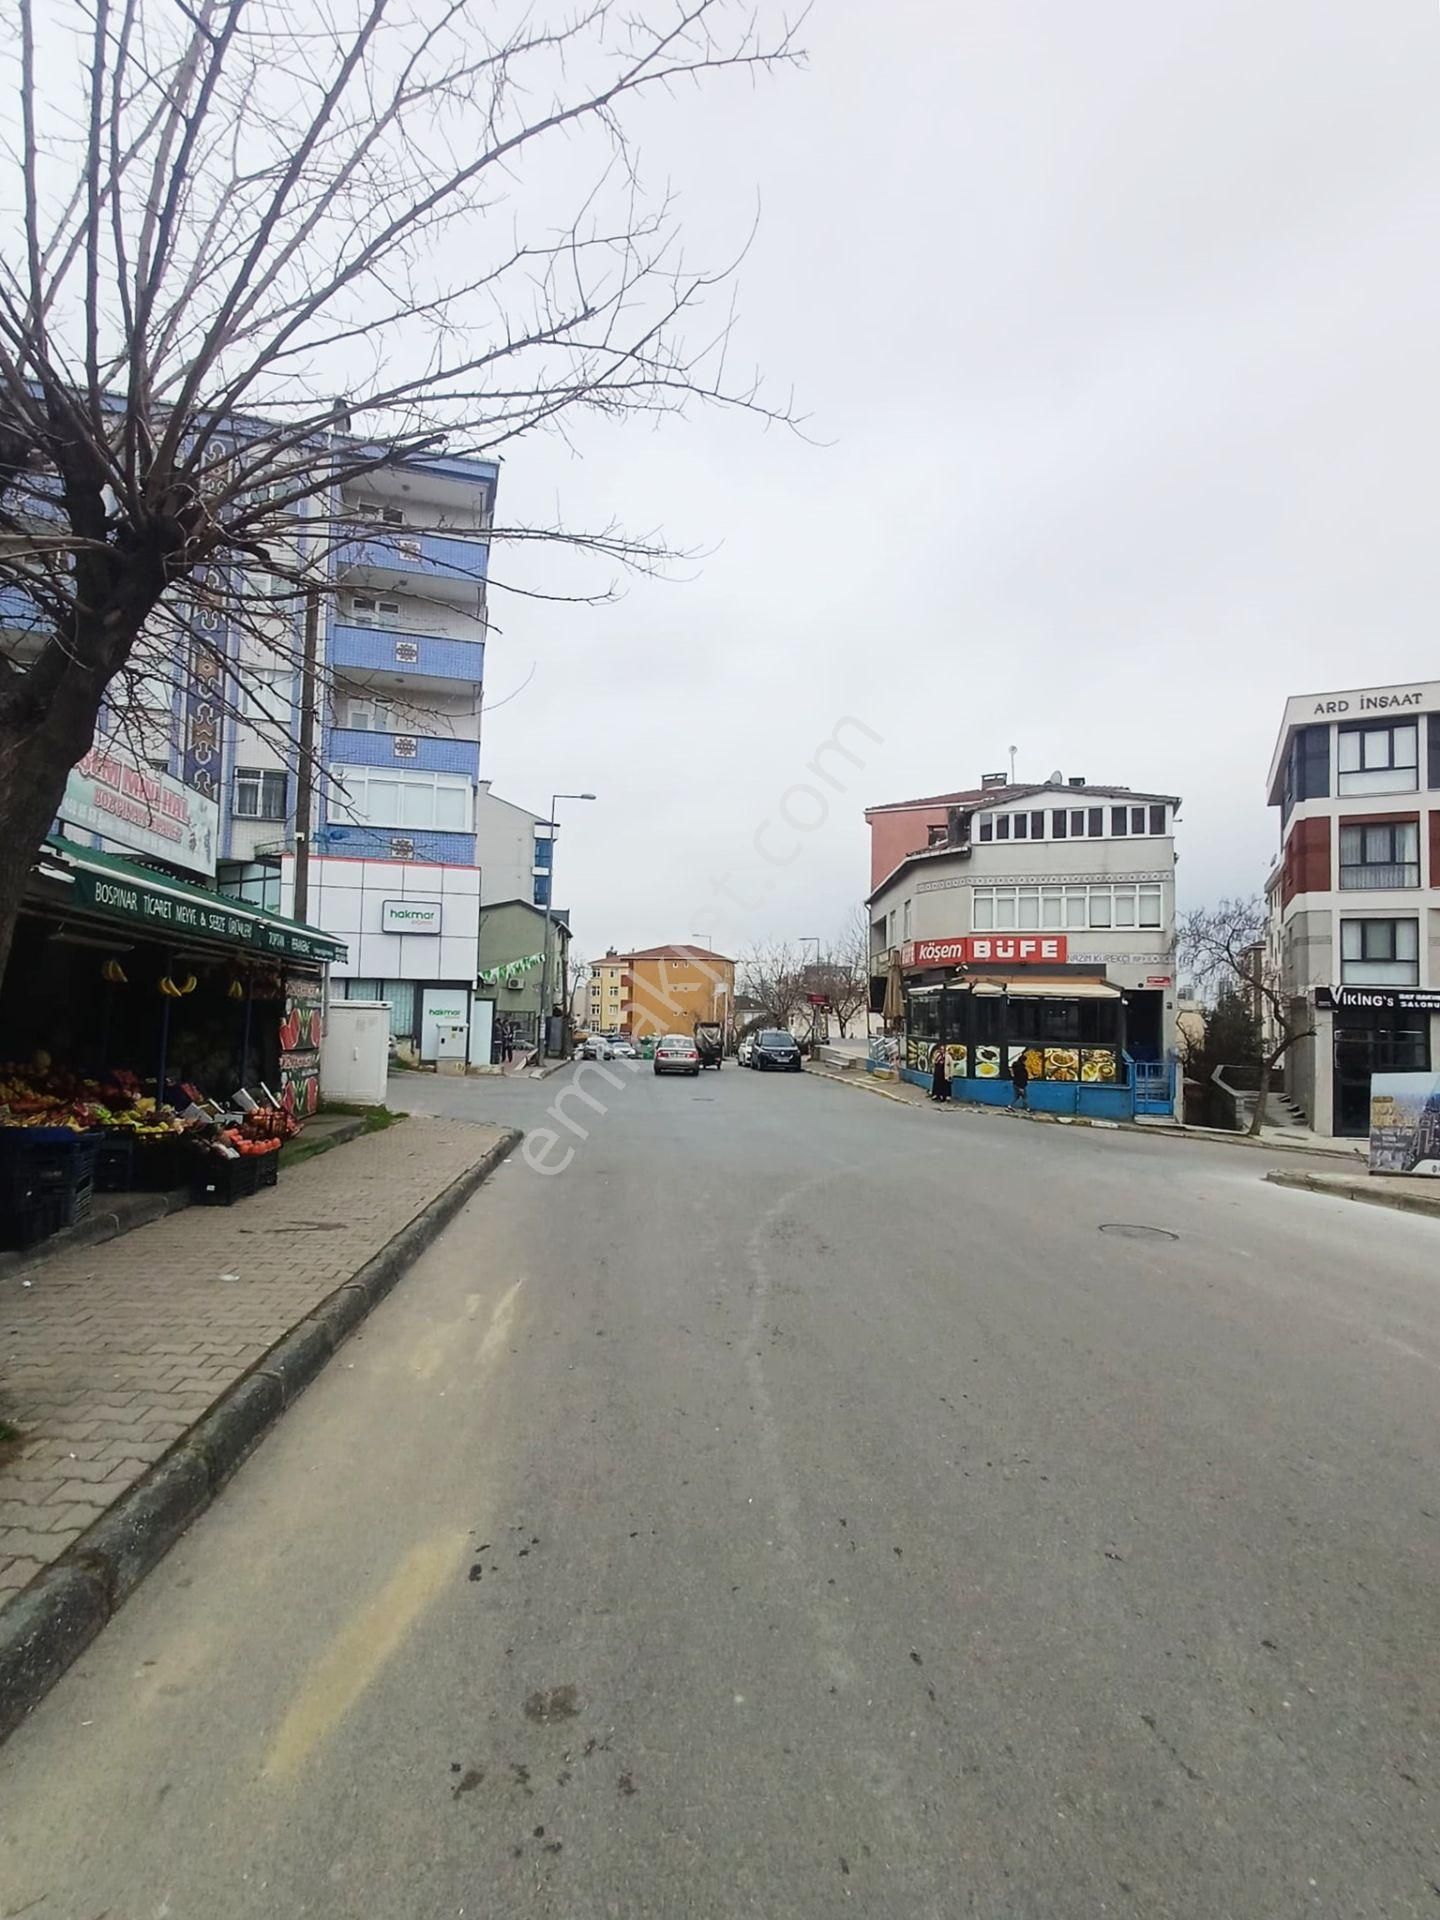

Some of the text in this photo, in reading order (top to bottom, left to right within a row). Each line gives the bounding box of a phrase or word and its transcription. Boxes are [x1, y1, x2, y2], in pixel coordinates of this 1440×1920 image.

[1314, 701, 1349, 714] ARD
[95, 882, 138, 911] BOSPINAR
[144, 894, 172, 919] TİCARET
[390, 909, 434, 919] hakmar
[919, 944, 962, 962] köşem
[973, 940, 1058, 958] BÜFE
